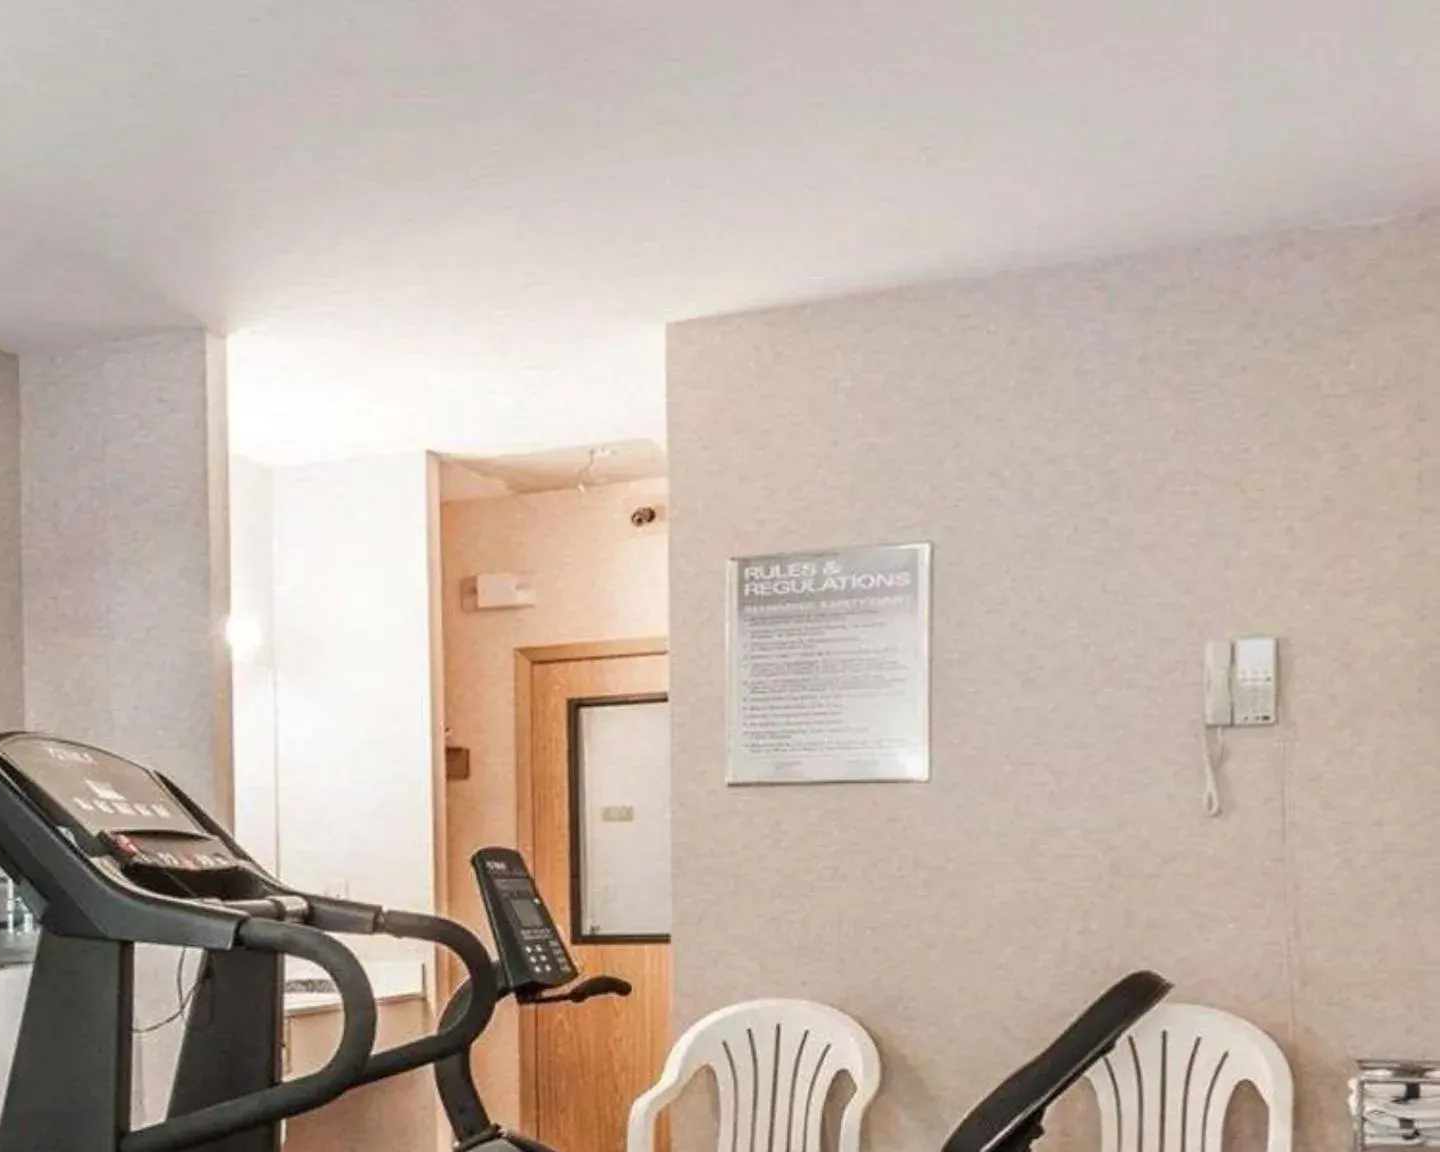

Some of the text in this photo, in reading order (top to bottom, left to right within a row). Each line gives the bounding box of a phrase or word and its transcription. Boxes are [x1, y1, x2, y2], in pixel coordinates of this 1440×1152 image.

[743, 560, 843, 581] RULES &
[743, 571, 912, 597] REGULATIONS
